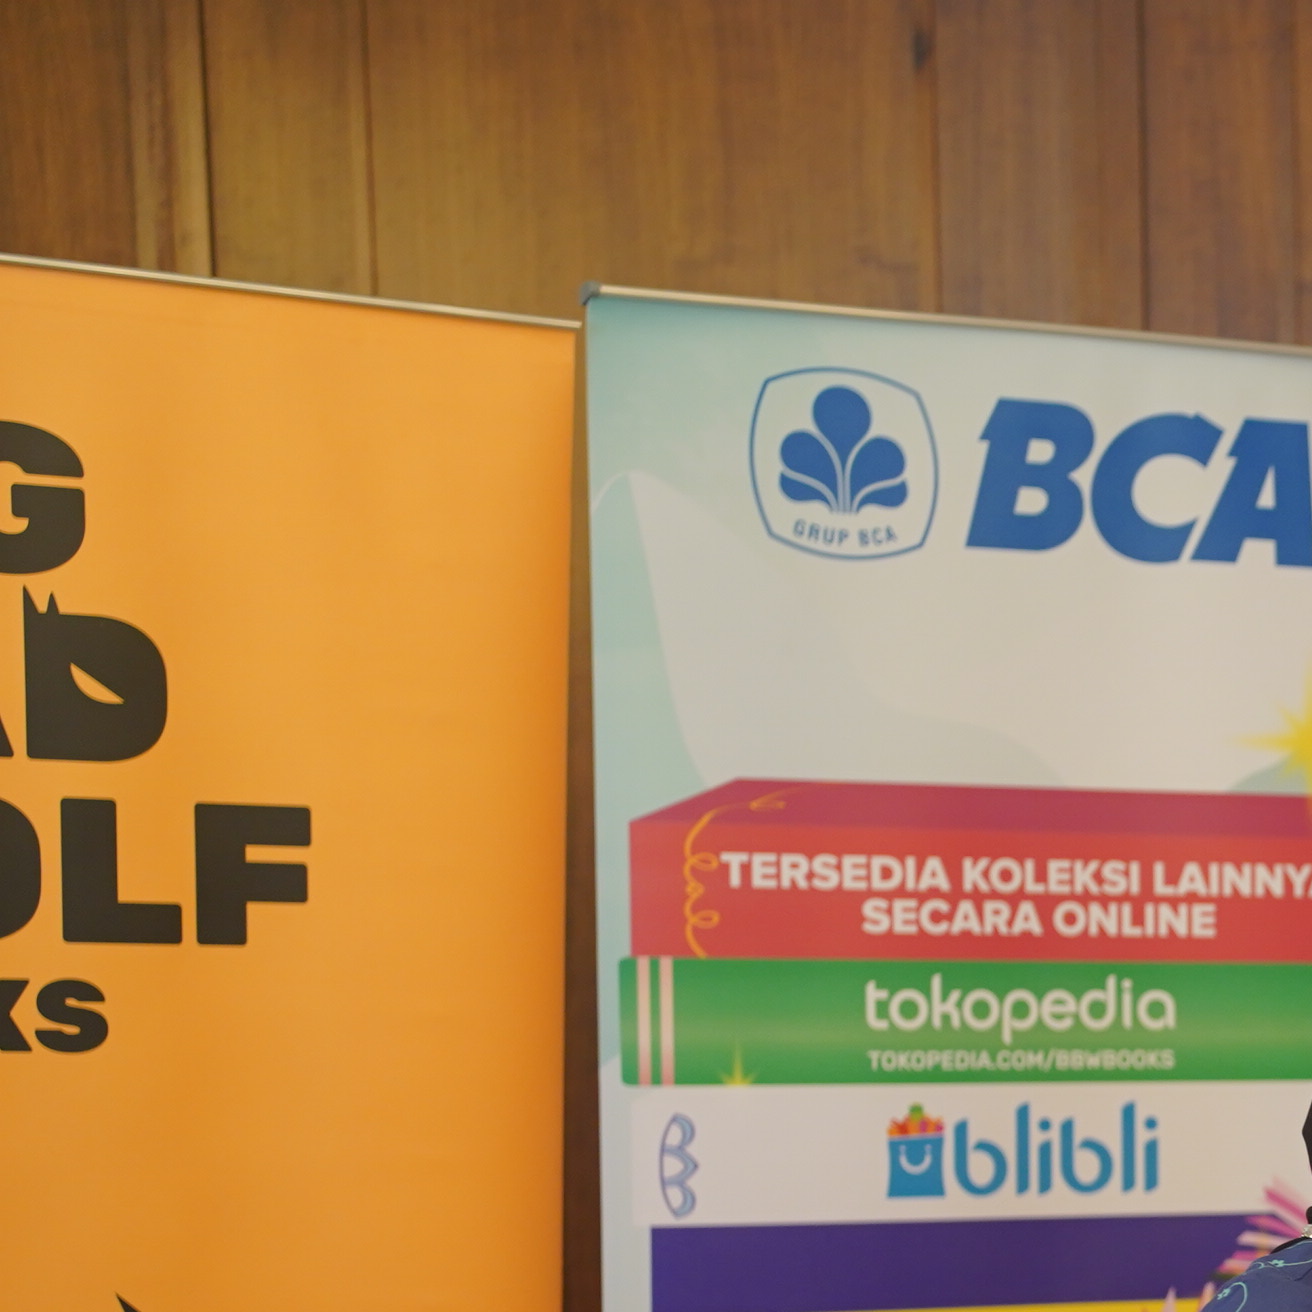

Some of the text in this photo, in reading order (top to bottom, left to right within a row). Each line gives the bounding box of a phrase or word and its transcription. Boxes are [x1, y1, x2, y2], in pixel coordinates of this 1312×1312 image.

[793, 518, 898, 547] GRUP BCA
[719, 850, 950, 893] TERSEDIA
[962, 857, 1140, 897] KOLEKSI
[862, 898, 1216, 939] SECARA ONLINE
[864, 972, 1177, 1045] tokopedia
[866, 1046, 1176, 1073] TOKOPEDIA.COM/BBWBOOKS
[952, 1099, 1160, 1198] blibli
